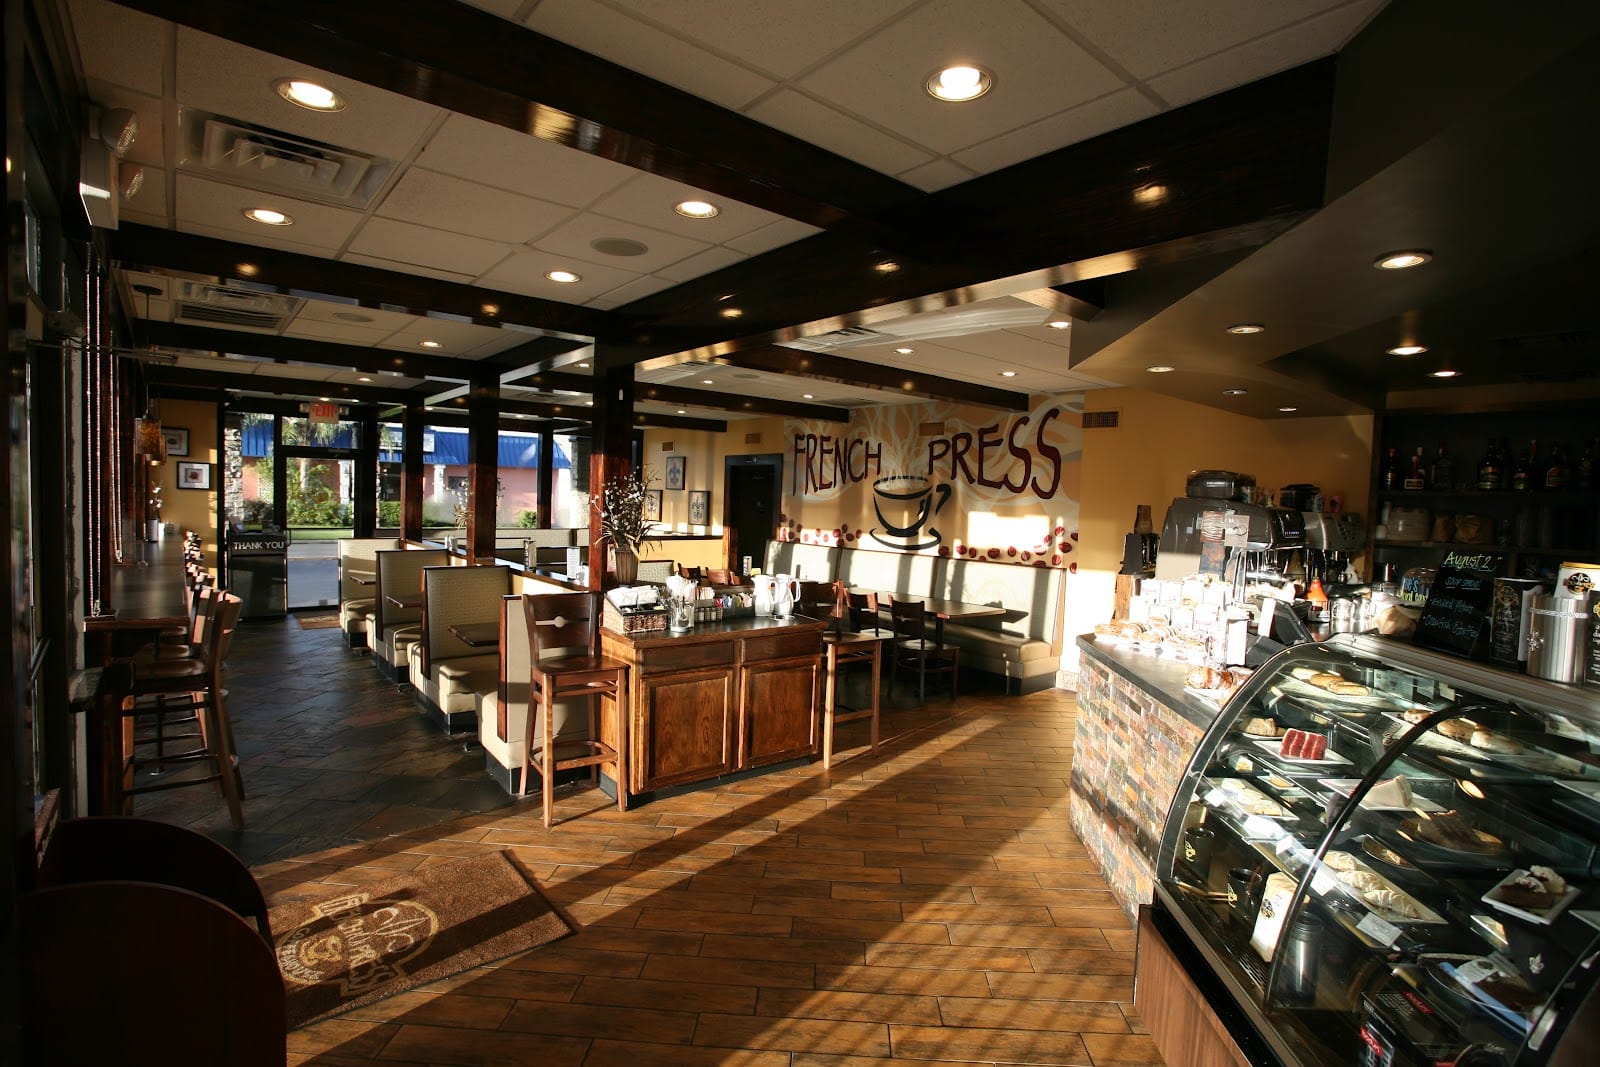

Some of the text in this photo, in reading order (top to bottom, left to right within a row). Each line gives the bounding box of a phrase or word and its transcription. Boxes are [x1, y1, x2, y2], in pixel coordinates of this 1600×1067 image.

[313, 403, 337, 417] EXIT
[793, 408, 1062, 500] FRENCH PRESS
[232, 541, 284, 550] THANK YOU
[1443, 552, 1485, 571] August
